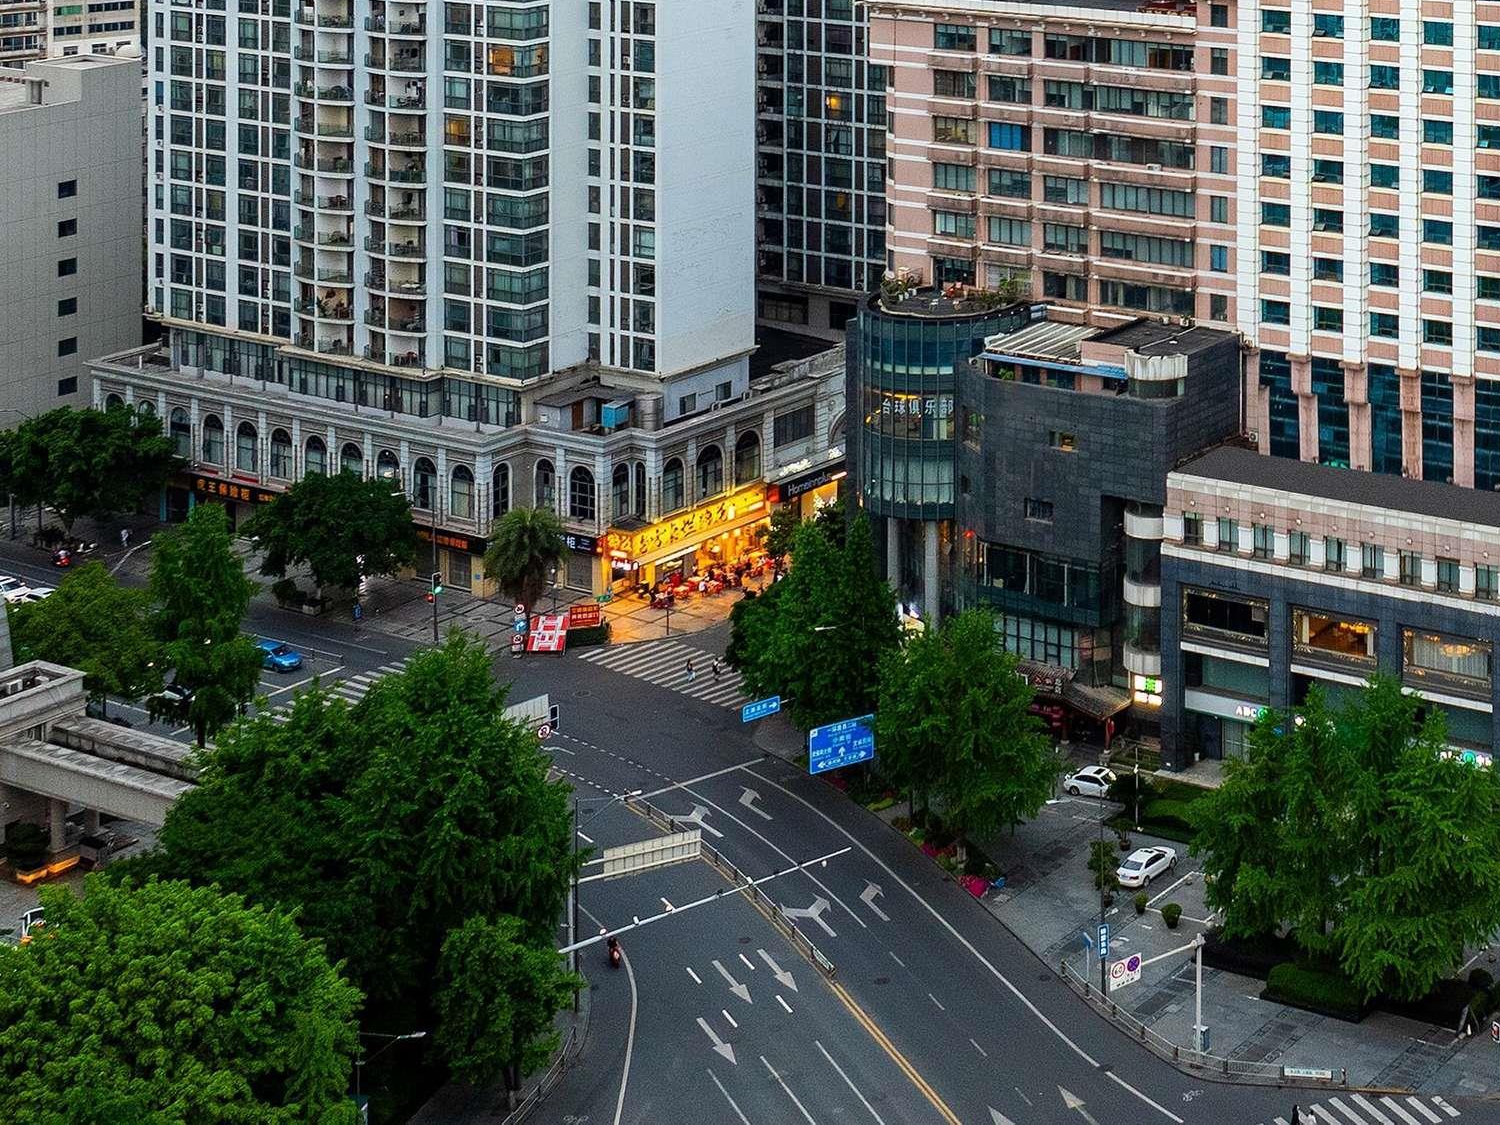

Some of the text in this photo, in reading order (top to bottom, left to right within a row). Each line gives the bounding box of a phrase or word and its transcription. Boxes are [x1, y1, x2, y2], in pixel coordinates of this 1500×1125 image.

[882, 398, 954, 415] 台球俱乐部
